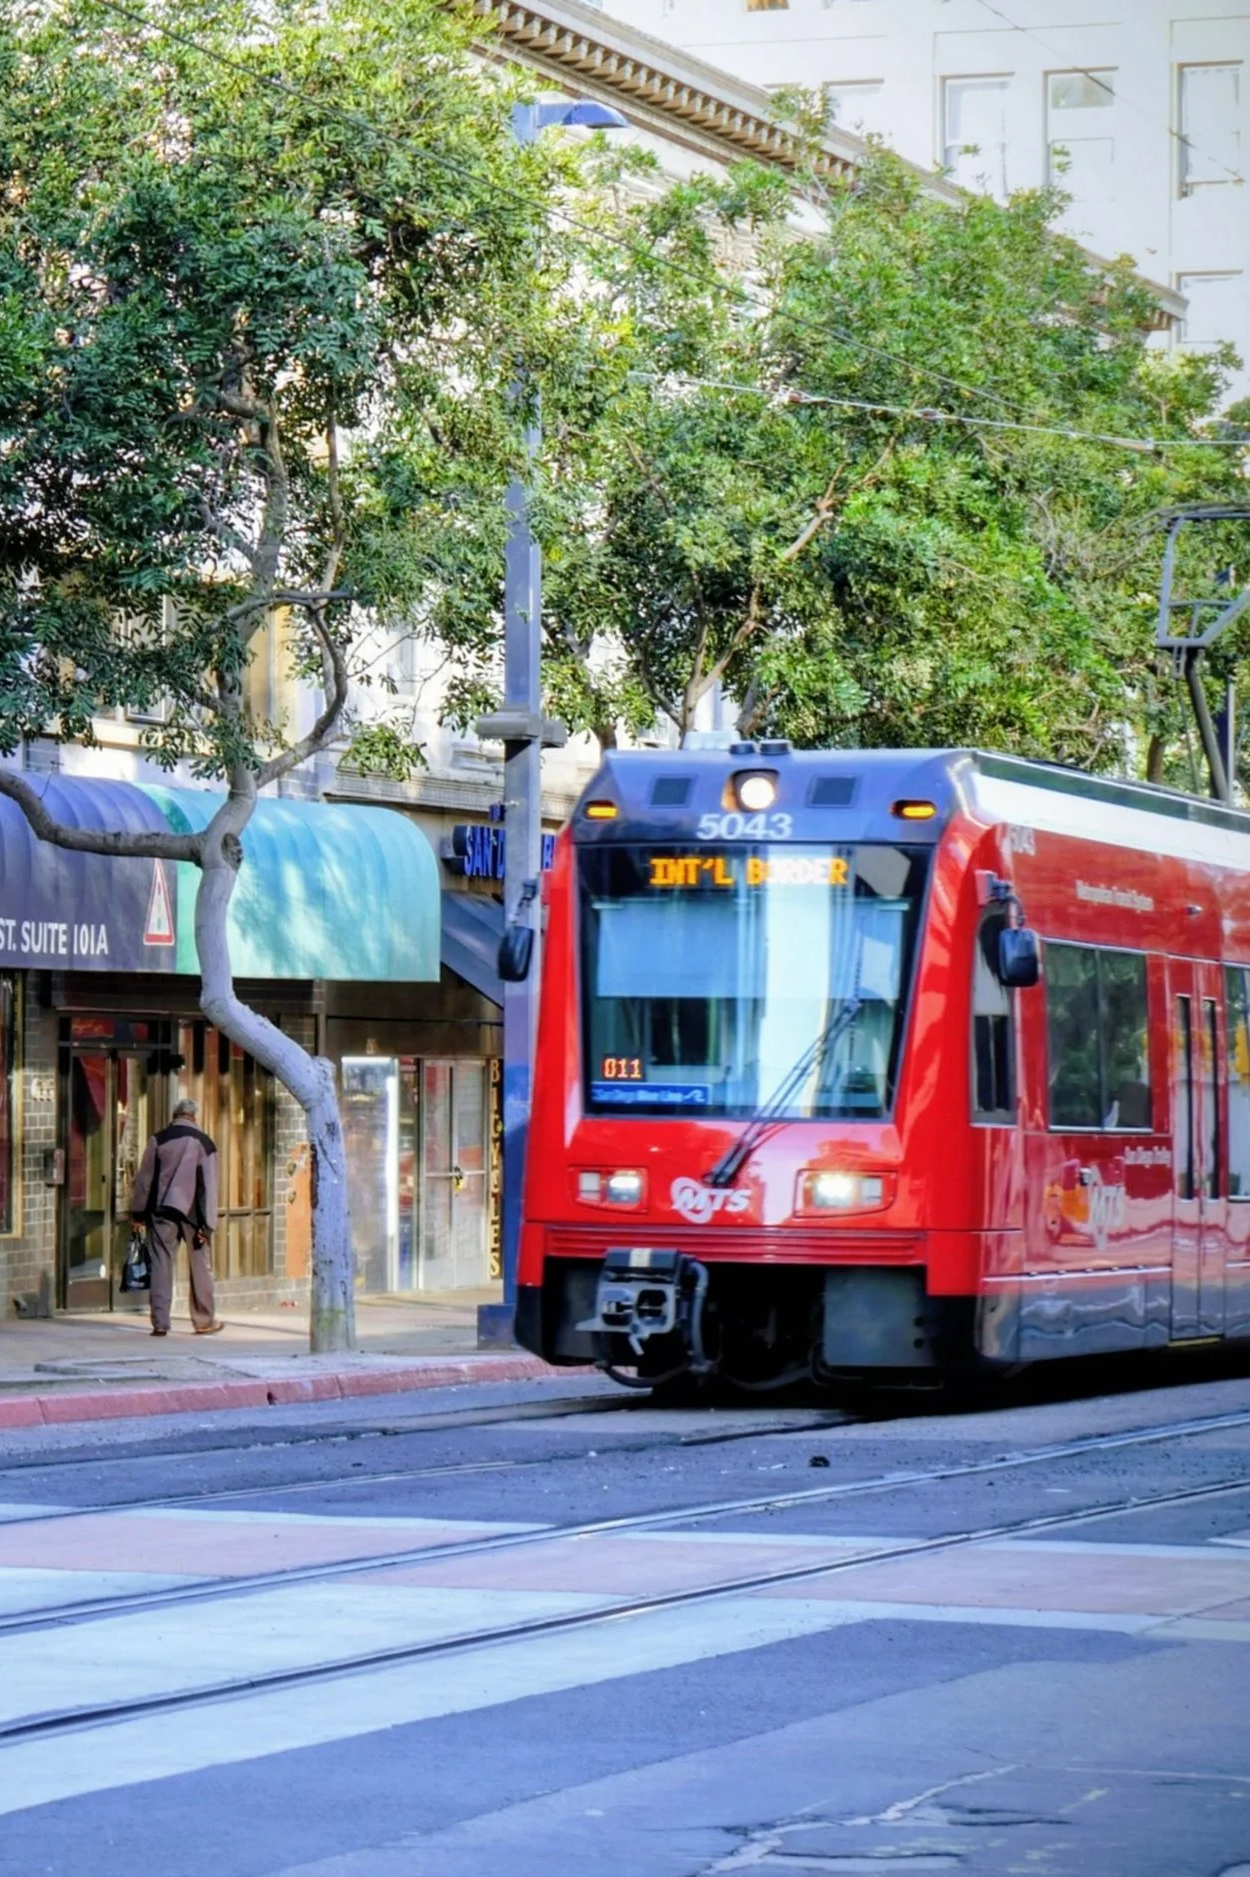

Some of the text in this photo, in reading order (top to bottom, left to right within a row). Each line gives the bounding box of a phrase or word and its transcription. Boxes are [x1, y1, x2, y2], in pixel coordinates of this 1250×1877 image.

[697, 813, 792, 840] 5043
[650, 858, 848, 886] INT'L BORDER
[20, 920, 68, 955] SUITE
[603, 1058, 642, 1079] 011
[672, 1186, 751, 1214] MTS
